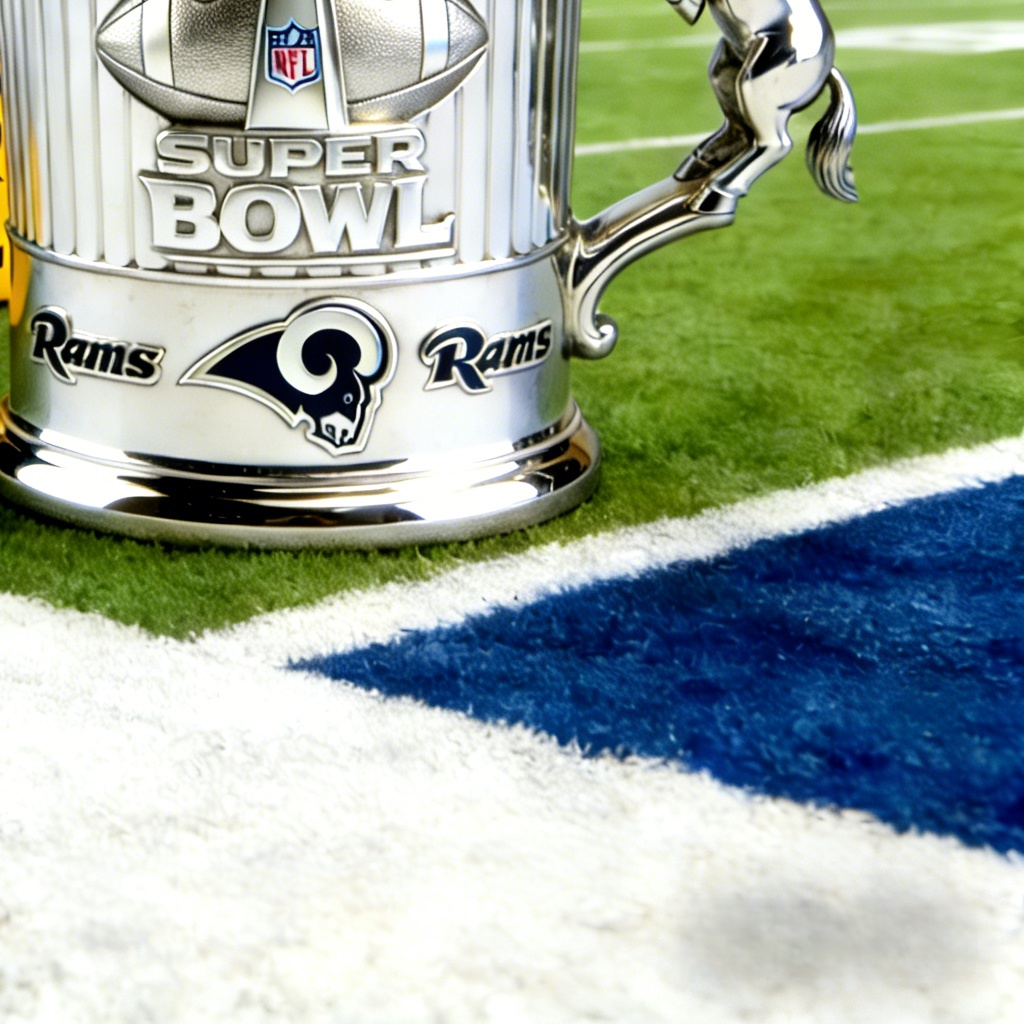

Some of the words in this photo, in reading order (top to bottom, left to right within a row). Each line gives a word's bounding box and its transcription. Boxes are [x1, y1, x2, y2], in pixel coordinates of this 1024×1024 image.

[272, 48, 316, 79] NFL
[156, 129, 427, 177] SUPER
[140, 172, 456, 255] BOWL
[31, 306, 163, 385] Rams
[420, 319, 554, 395] Rams
